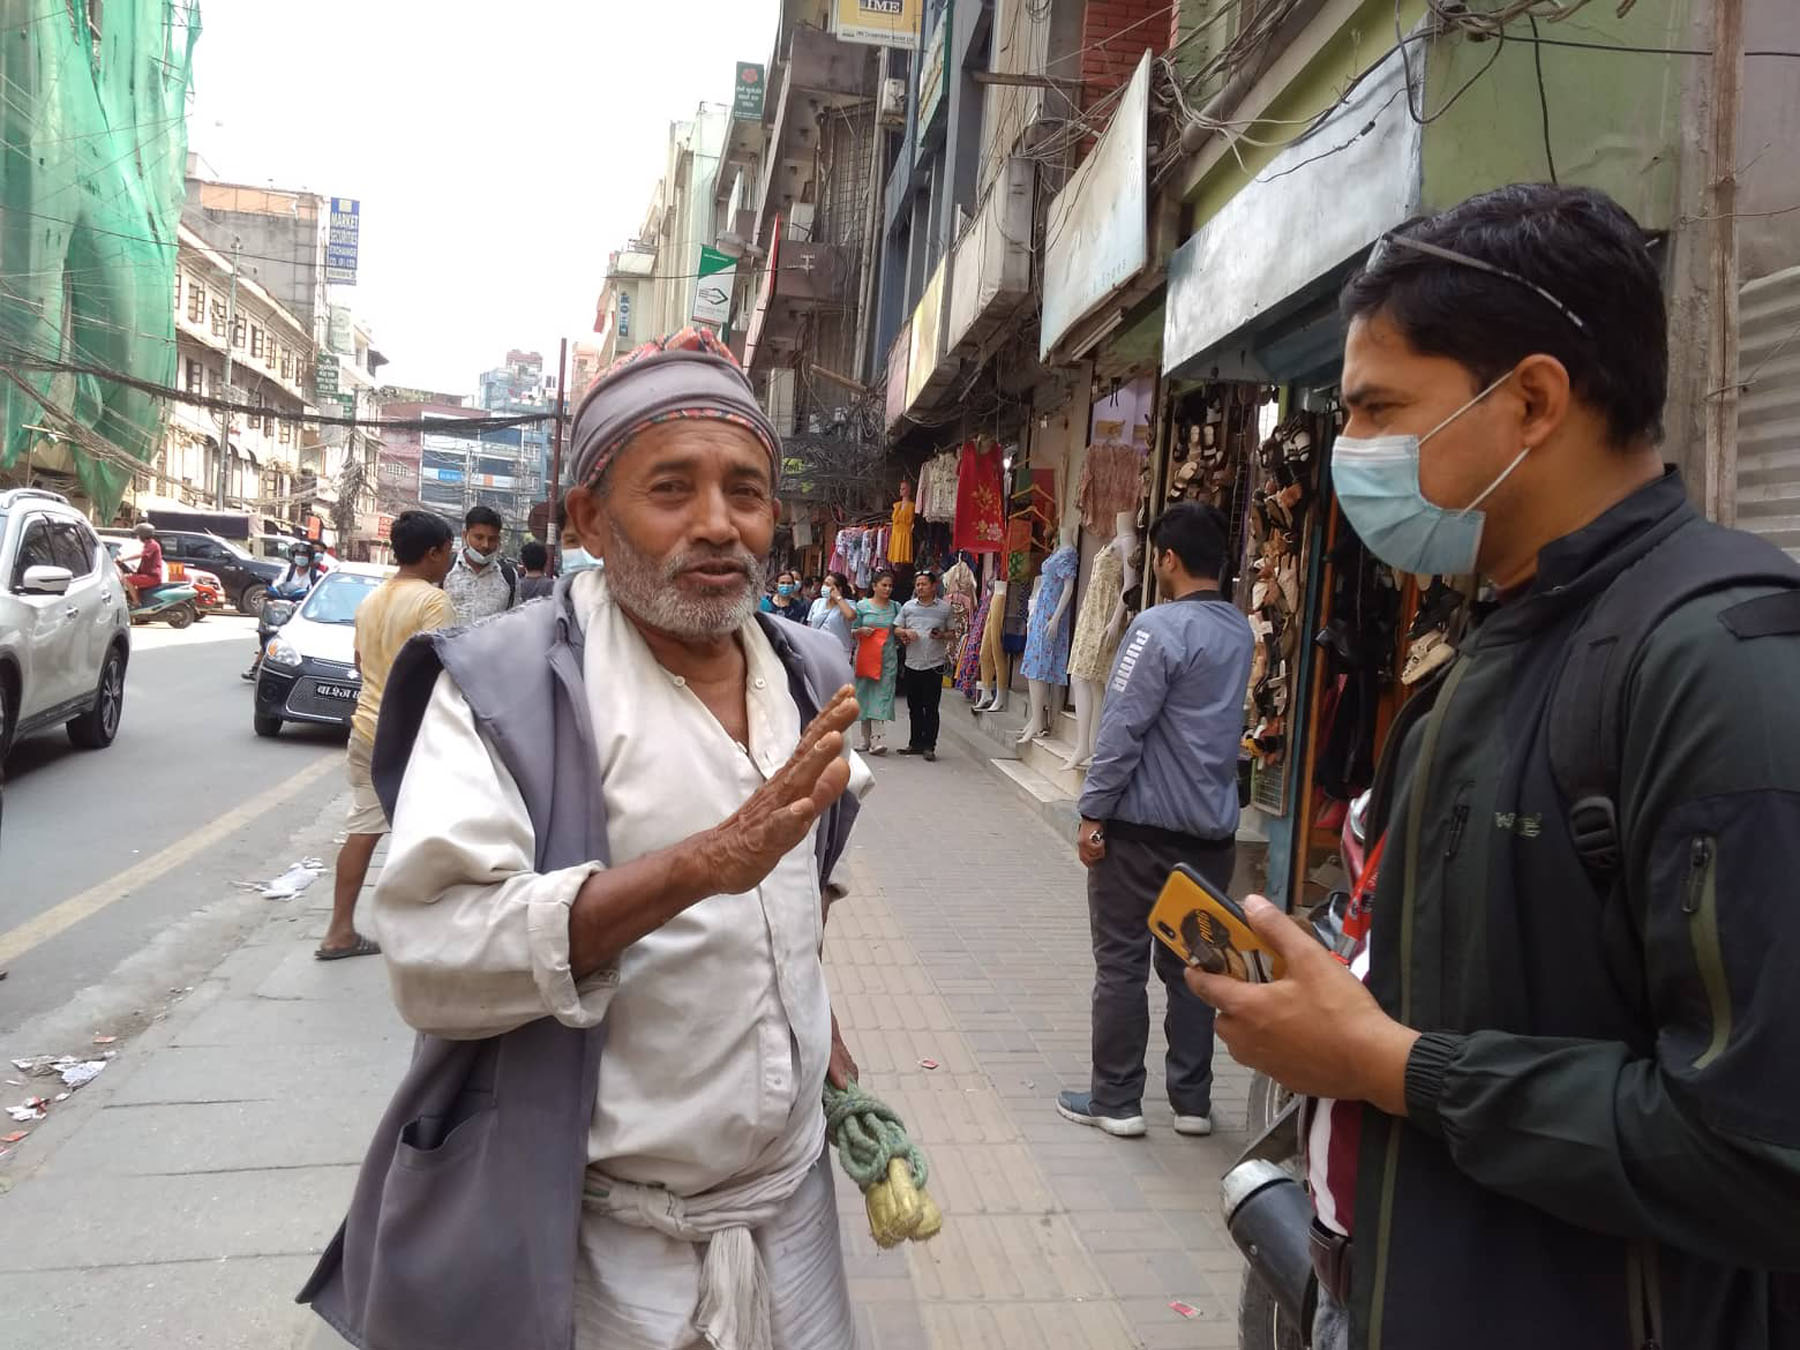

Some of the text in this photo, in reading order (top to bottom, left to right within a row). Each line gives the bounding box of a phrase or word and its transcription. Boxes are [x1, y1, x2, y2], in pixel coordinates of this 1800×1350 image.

[867, 0, 900, 14] IME
[331, 212, 358, 229] MARKET
[1110, 629, 1151, 693] PUMA
